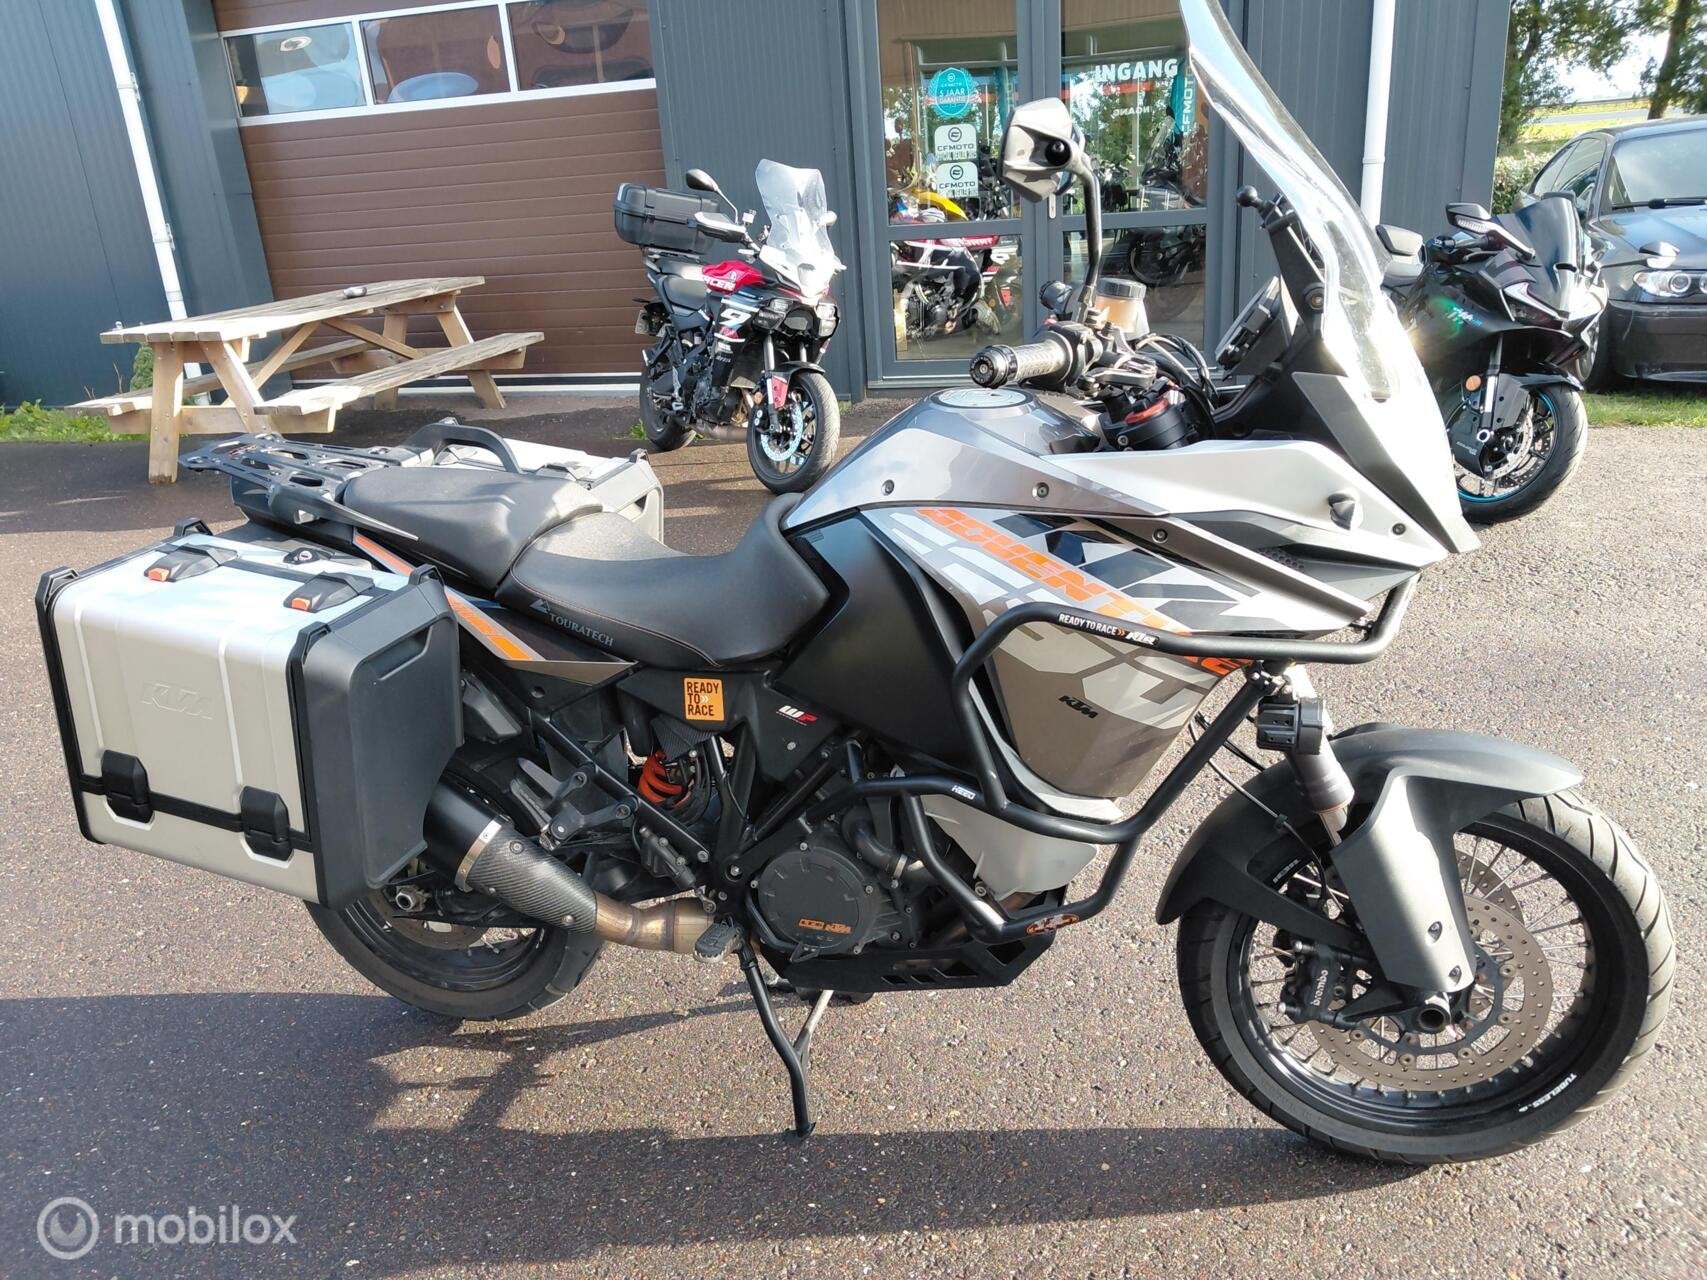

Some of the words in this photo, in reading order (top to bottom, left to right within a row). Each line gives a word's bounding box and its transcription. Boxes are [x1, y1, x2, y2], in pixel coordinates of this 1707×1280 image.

[1095, 59, 1178, 82] INGANG
[946, 88, 965, 96] JAAR
[937, 143, 975, 151] CFMOTO
[939, 181, 976, 189] CFMOTO
[549, 613, 614, 646] TOURATECH
[1058, 613, 1086, 627] READY
[1086, 620, 1096, 629] TO
[1097, 623, 1117, 635] RACE
[687, 682, 719, 694] READY
[688, 693, 700, 704] TO
[688, 704, 714, 716] RACE
[1058, 695, 1098, 718] KTM
[1310, 969, 1328, 1007] brembo
